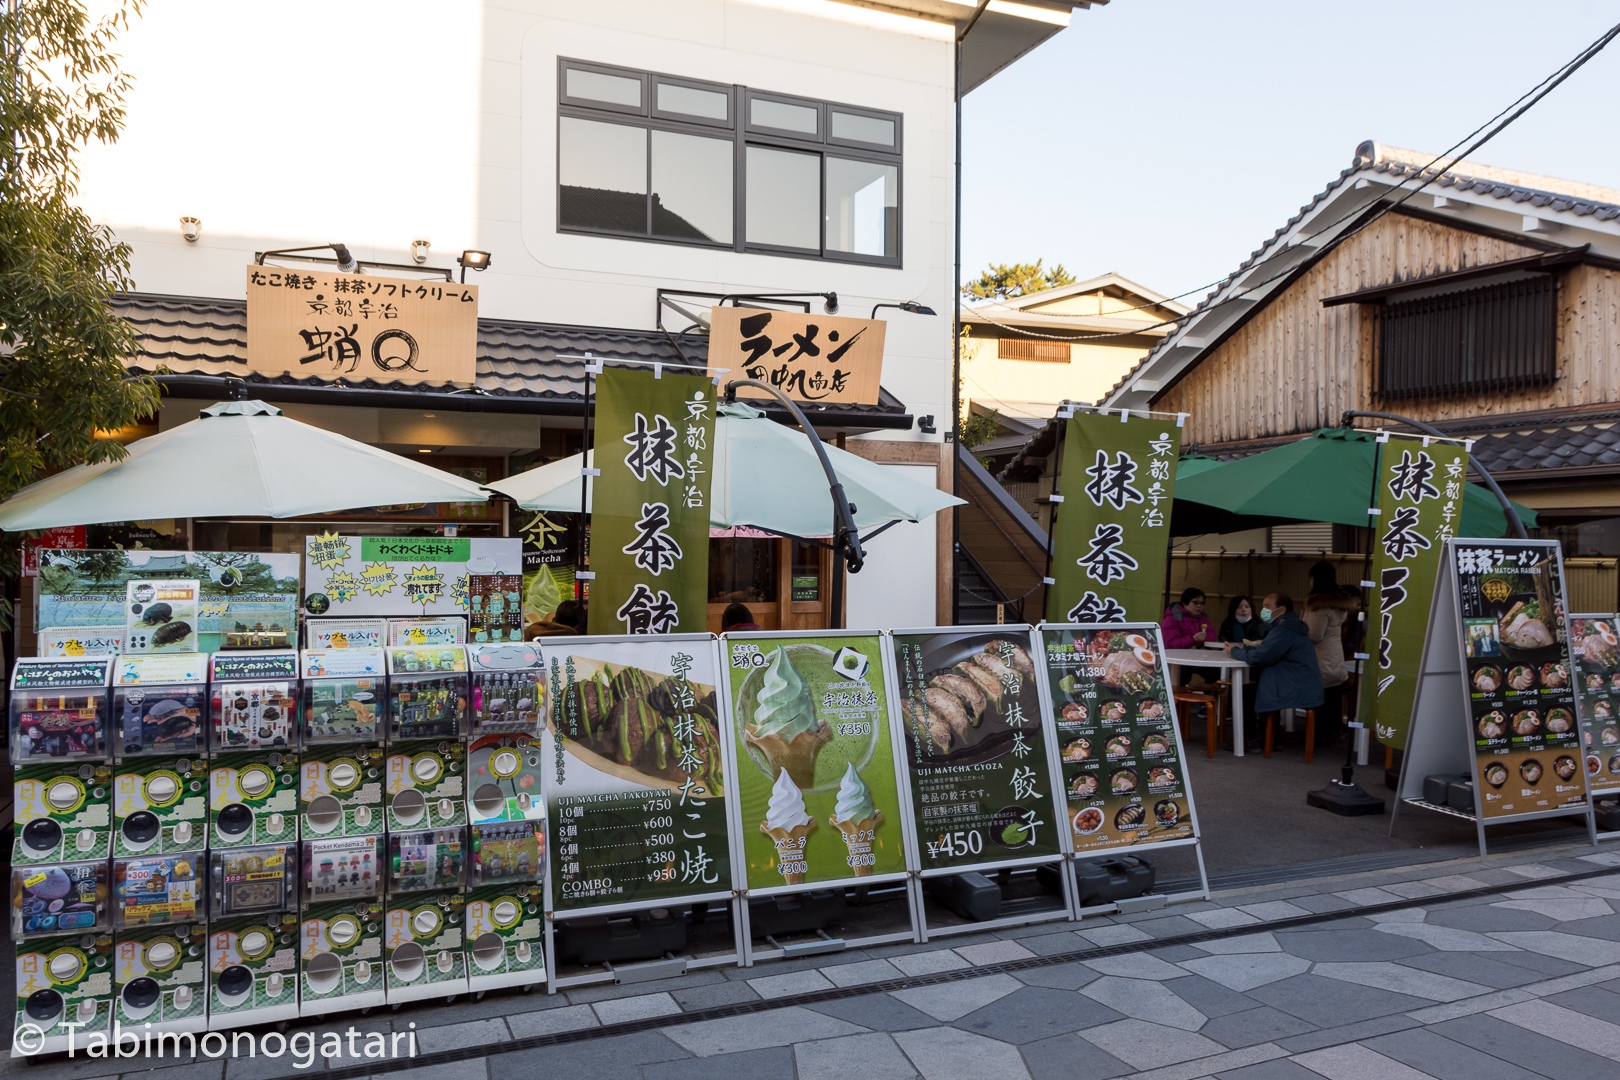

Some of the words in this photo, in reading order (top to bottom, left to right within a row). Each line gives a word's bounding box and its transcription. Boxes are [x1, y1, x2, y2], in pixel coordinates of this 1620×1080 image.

[306, 294, 399, 320] 京都宇治
[740, 312, 867, 367] ラーメン
[683, 390, 711, 508] 京都宇治
[1141, 432, 1175, 528] 京都宇治
[1435, 456, 1464, 542] 京都宇治
[379, 544, 454, 555] わくわくドキドキ
[527, 555, 562, 565] Matcha
[1457, 548, 1540, 575] 抹茶ラーメン
[1494, 567, 1520, 575] MATCHA
[407, 584, 441, 595] 売れてます
[1048, 652, 1104, 661] スタミナ塩ラーメン
[1075, 666, 1107, 677] ¥1,380
[823, 691, 878, 708] 宇治抹茶
[1081, 691, 1097, 699] ¥100
[837, 722, 871, 736] ¥350
[998, 641, 1045, 846] 宇治抹茶餃子
[671, 651, 719, 885] 宇治抹茶たこ焼
[918, 768, 931, 776] UJI
[934, 765, 971, 774] MATCHA
[974, 762, 1004, 772] GYOZA
[558, 797, 574, 806] UJI
[577, 793, 620, 804] MATCHA
[622, 789, 672, 800] TAKOYAKI
[559, 806, 584, 818] 10個
[642, 799, 672, 812] ¥750
[924, 803, 978, 818] 自家製の抹茶塩
[559, 825, 578, 837] 8個
[643, 816, 673, 829] ¥600
[560, 843, 579, 855] 6個
[644, 833, 674, 847] ¥500
[774, 836, 807, 849] バニラ
[841, 829, 875, 844] ミックス
[926, 830, 983, 859] ¥450
[333, 841, 359, 849] Kendama
[560, 862, 580, 874] 4個
[646, 851, 676, 864] ¥380
[777, 861, 808, 874] ¥300
[846, 853, 876, 867] ¥300
[128, 870, 149, 879] ¥300
[561, 878, 613, 893] COMBO
[647, 867, 677, 882] ¥950
